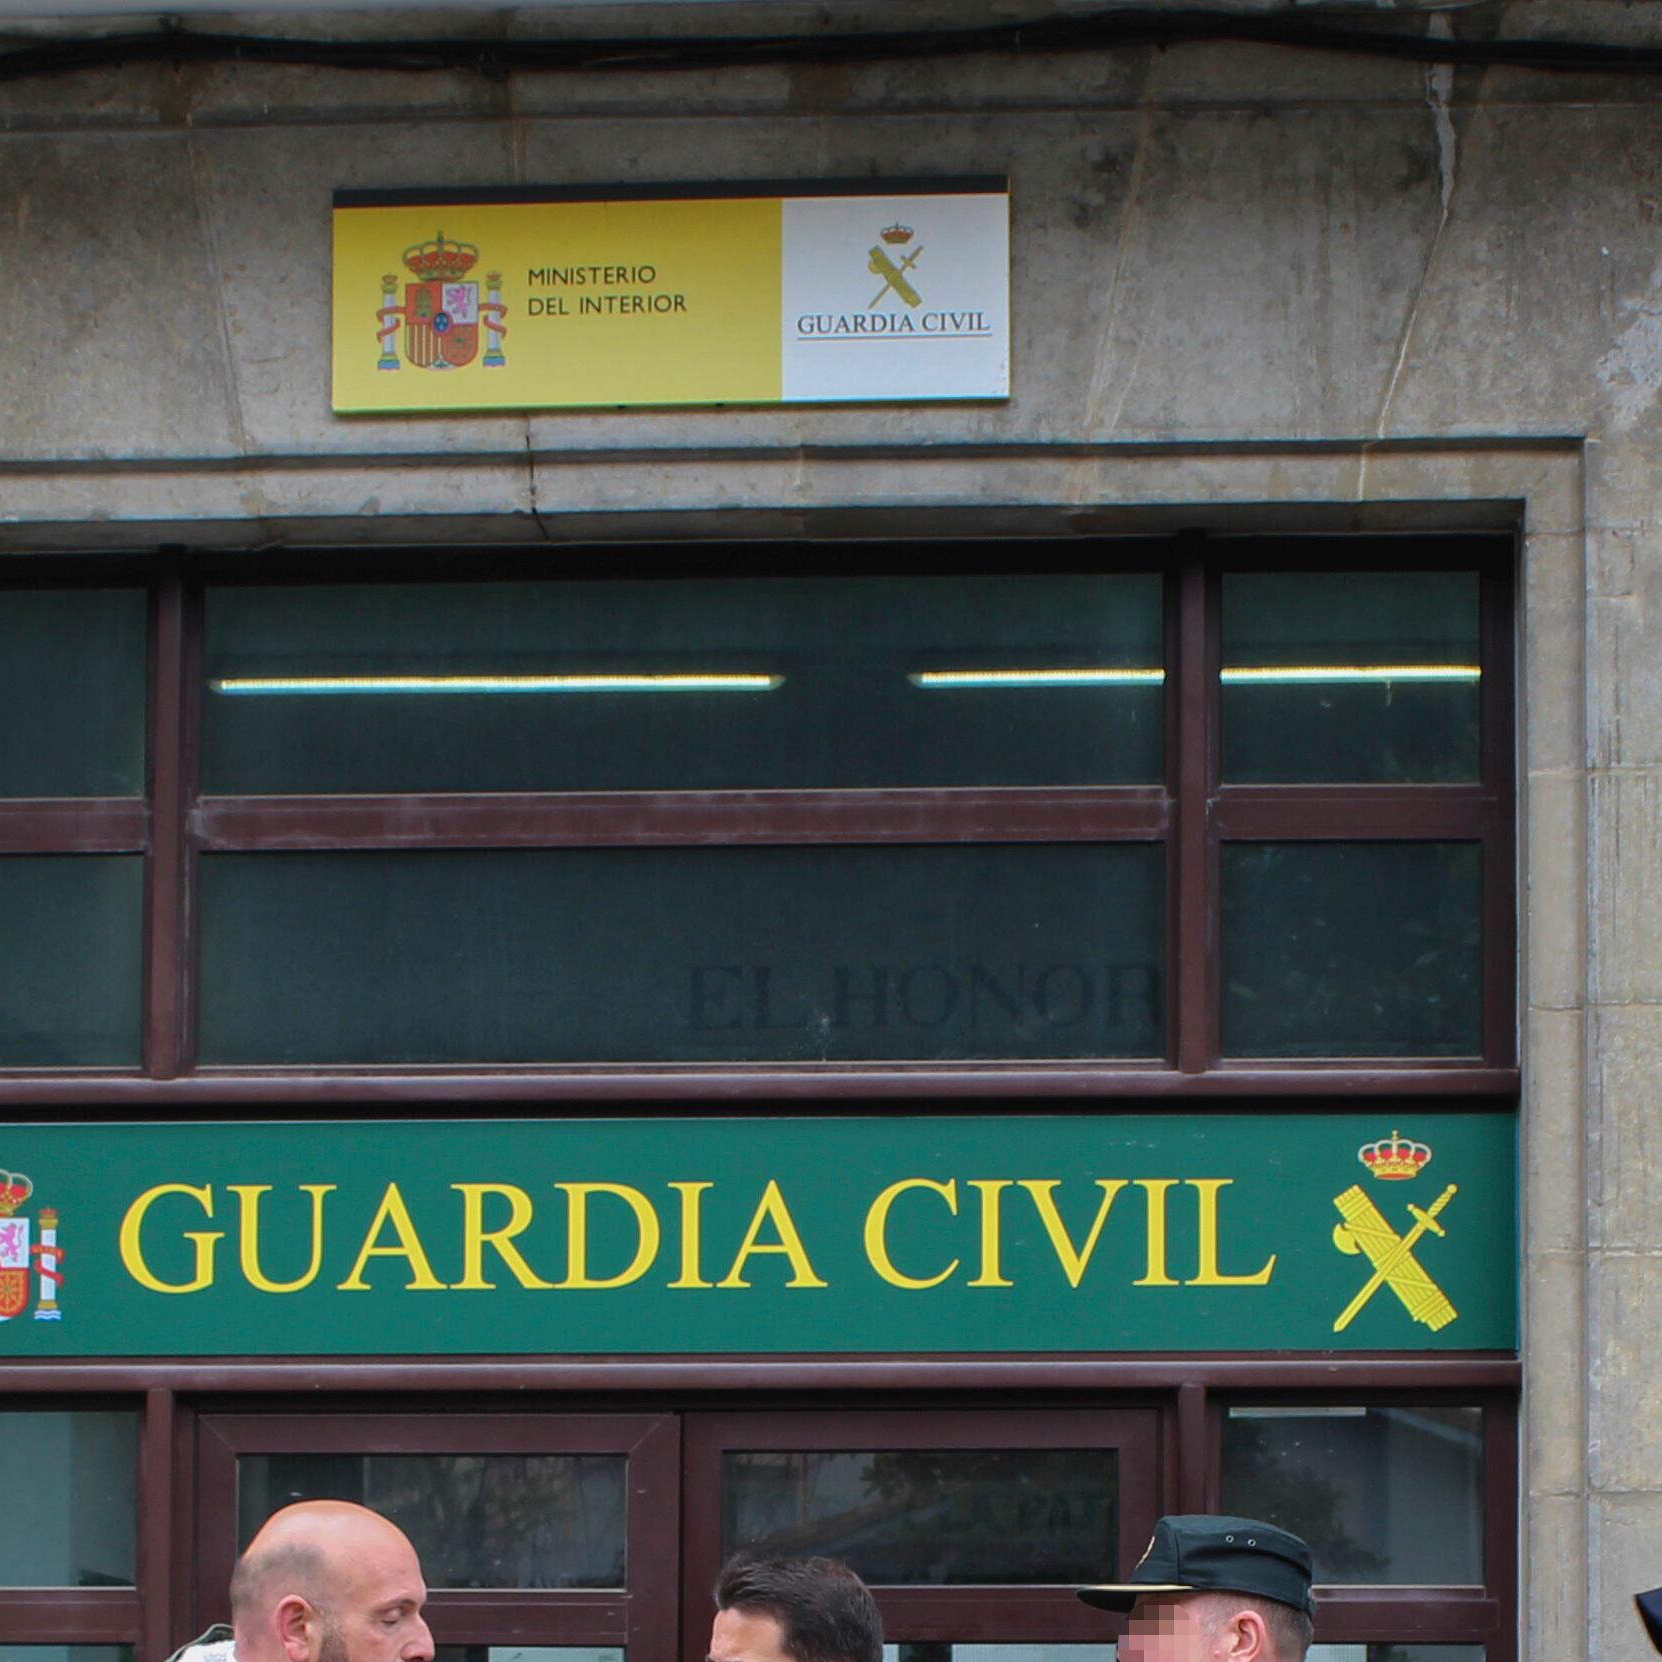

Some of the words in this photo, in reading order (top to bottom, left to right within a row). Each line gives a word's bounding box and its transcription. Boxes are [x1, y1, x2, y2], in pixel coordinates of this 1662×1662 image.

[527, 265, 656, 286] MINISTERIO
[527, 297, 570, 316] DEL
[579, 294, 688, 315] INTERIOR
[796, 313, 915, 335] GUARDIA
[921, 311, 991, 332] CIVIL
[689, 965, 807, 1031] EL
[829, 962, 1164, 1029] HONOR
[118, 1178, 829, 1295] GUARDIA
[862, 1177, 1277, 1290] CIVIL
